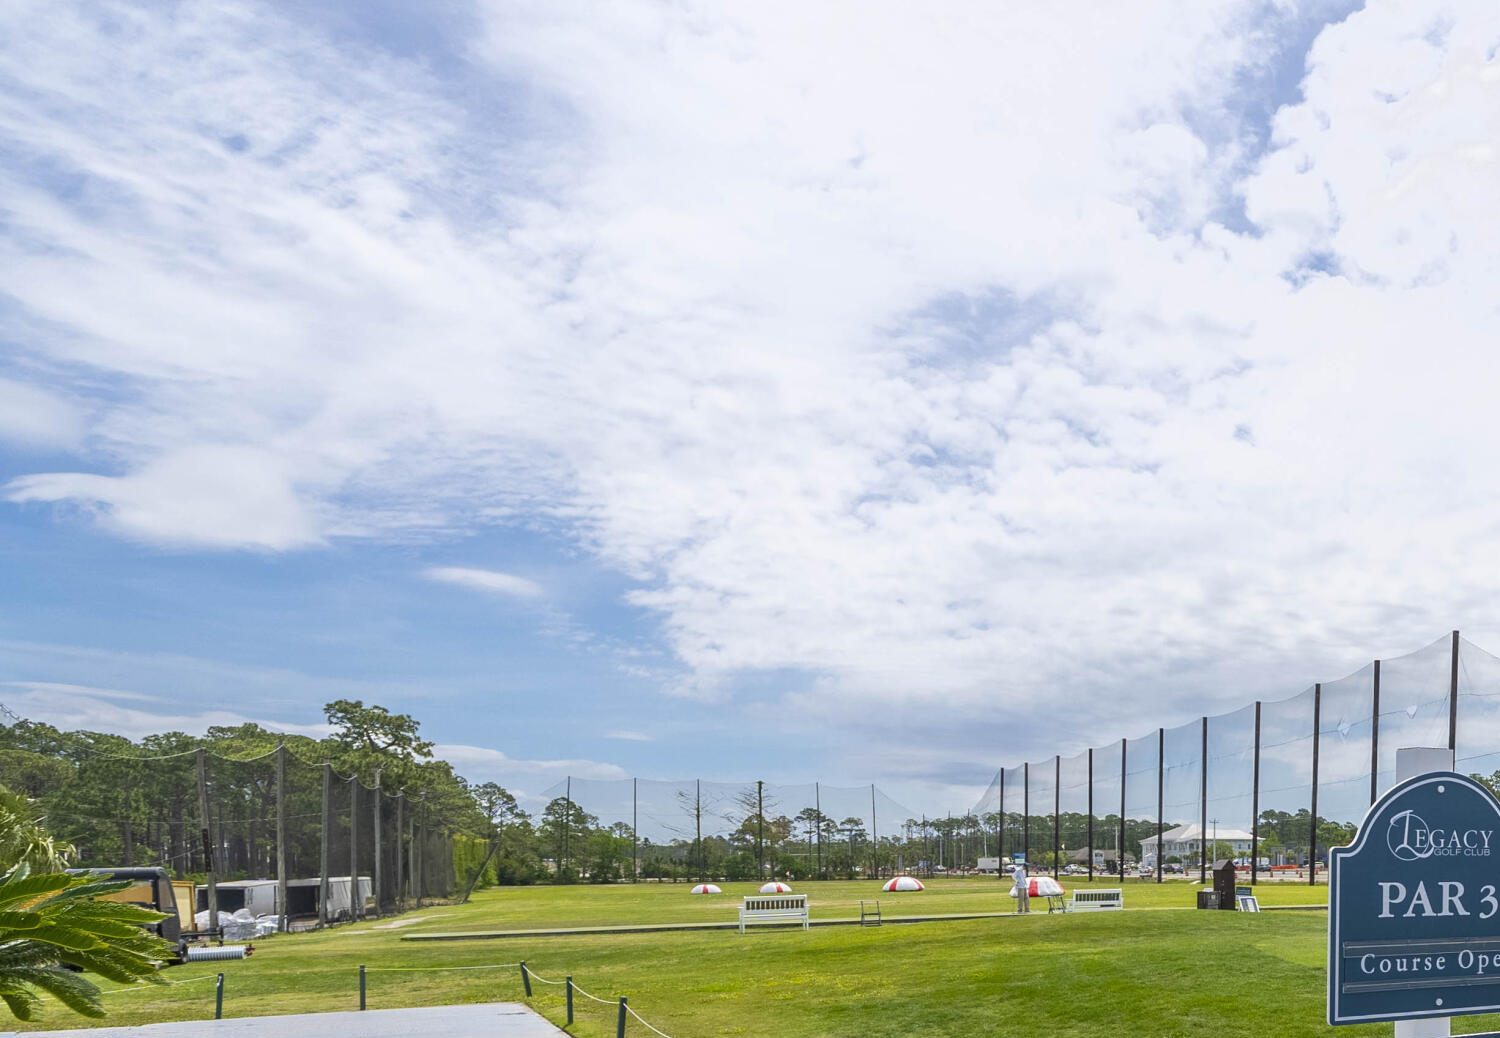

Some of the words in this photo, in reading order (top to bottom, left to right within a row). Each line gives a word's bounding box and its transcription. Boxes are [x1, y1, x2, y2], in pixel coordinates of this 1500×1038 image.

[1387, 810, 1493, 859] LEGACY
[1434, 848, 1461, 856] GOLF
[1464, 848, 1491, 856] CLUB
[1378, 881, 1470, 918] PAR
[1479, 885, 1499, 919] 3
[1360, 953, 1446, 974] Course
